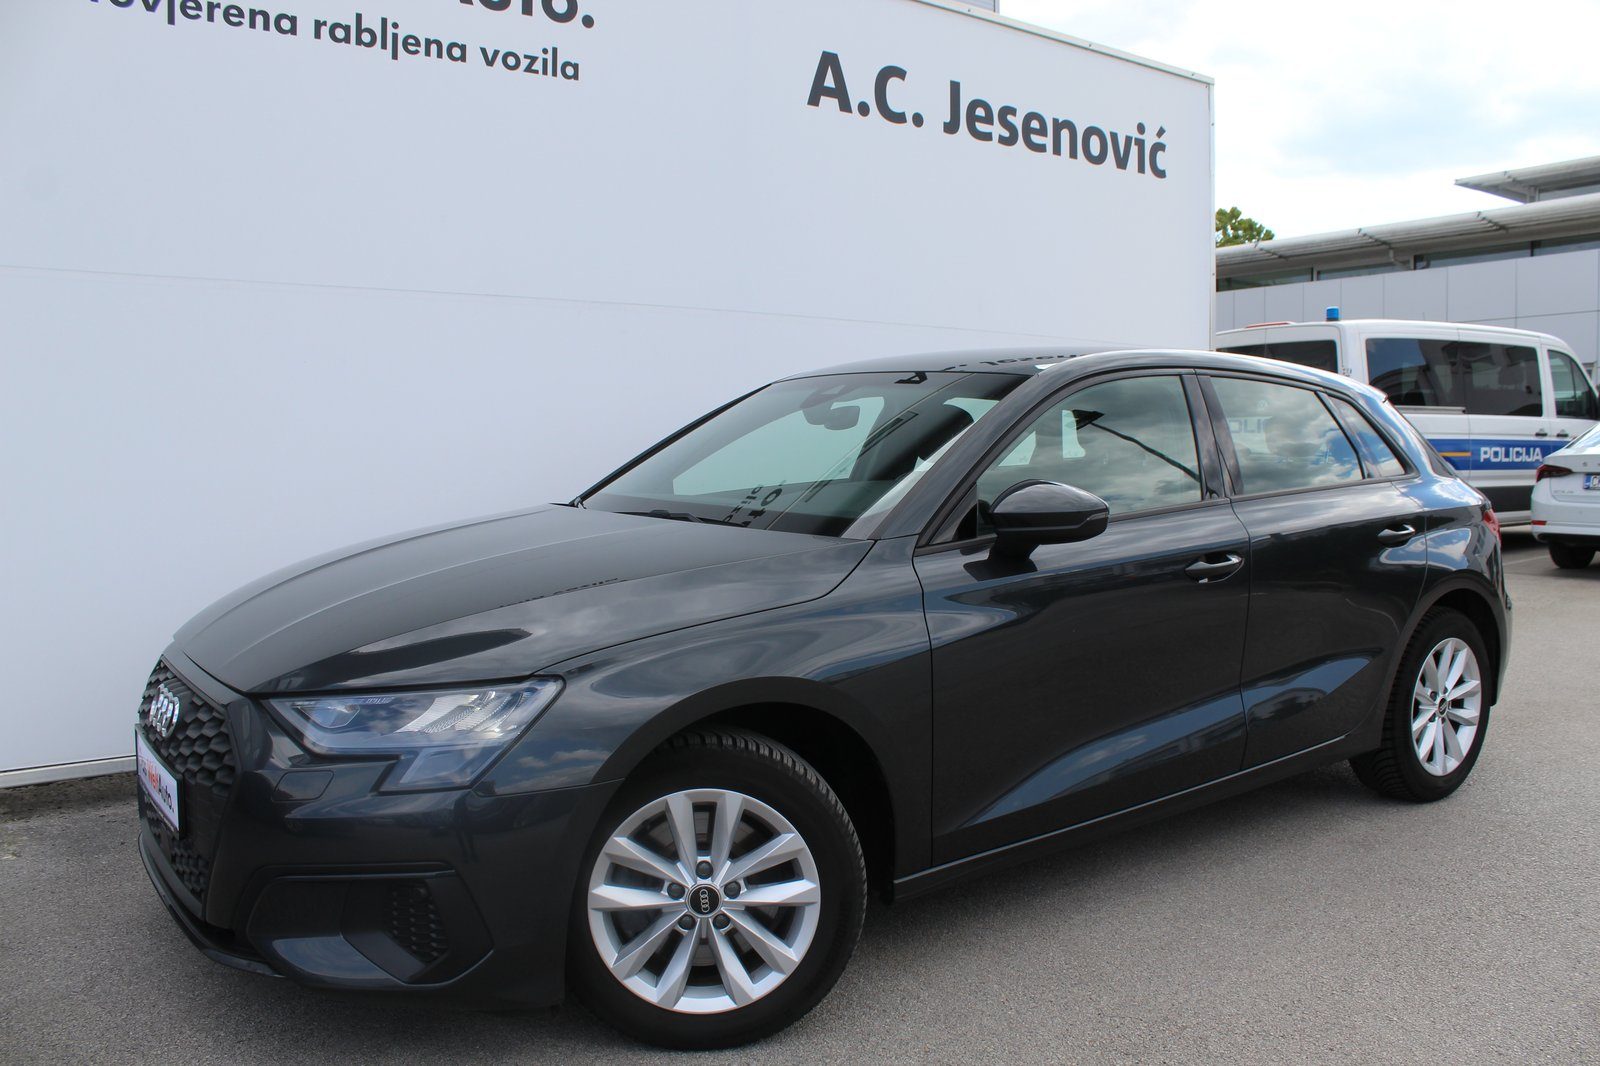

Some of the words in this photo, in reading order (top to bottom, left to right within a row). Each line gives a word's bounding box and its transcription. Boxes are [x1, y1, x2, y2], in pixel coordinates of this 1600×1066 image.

[89, 0, 298, 36] vjerena
[313, 13, 467, 62] rabljena
[480, 47, 580, 81] vozila
[807, 50, 924, 128] A.C.
[943, 80, 1167, 179] Jesenović
[1480, 447, 1543, 462] POLICIJA
